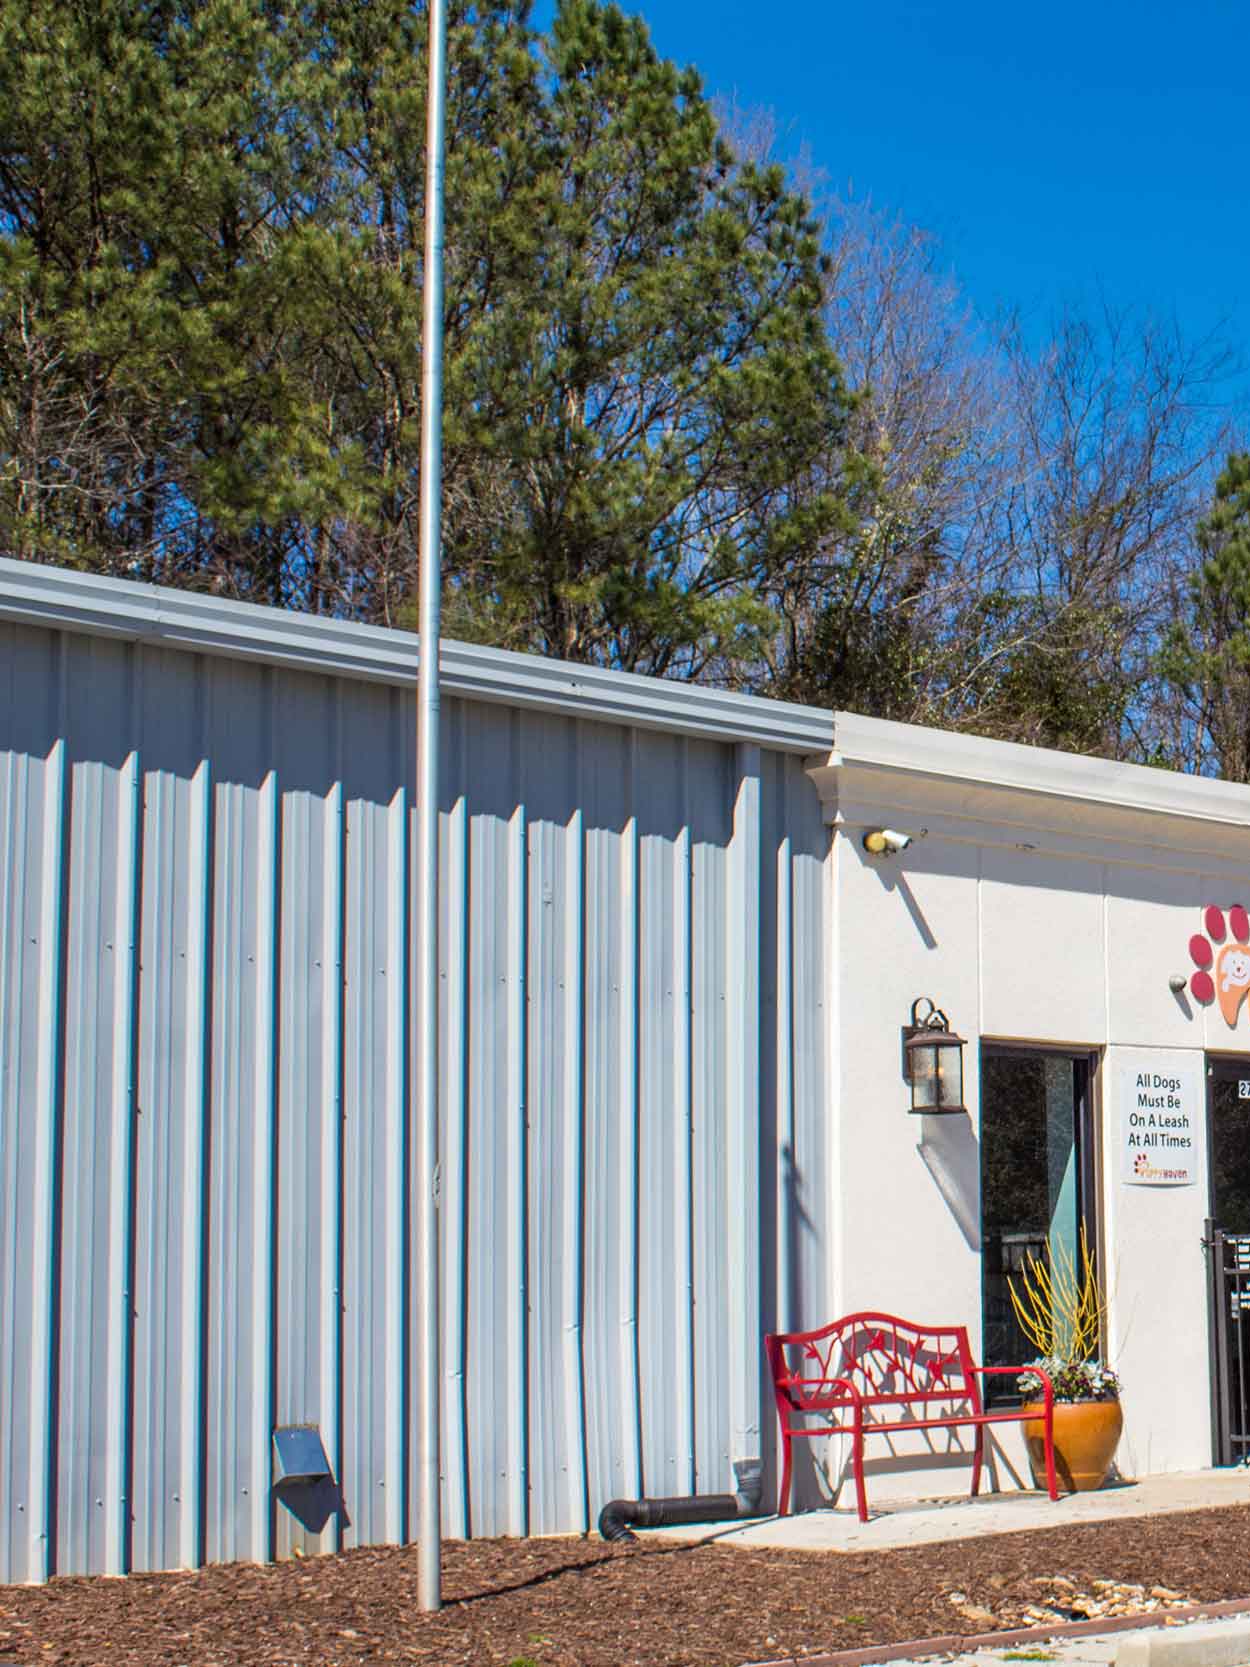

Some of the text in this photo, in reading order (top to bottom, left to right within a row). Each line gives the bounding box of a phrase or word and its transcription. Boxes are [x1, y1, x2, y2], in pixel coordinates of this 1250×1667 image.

[1136, 1073, 1181, 1092] All Dogs
[1137, 1093, 1181, 1109] Must Be
[1129, 1112, 1190, 1128] On A Leash
[1128, 1132, 1192, 1148] At All Times
